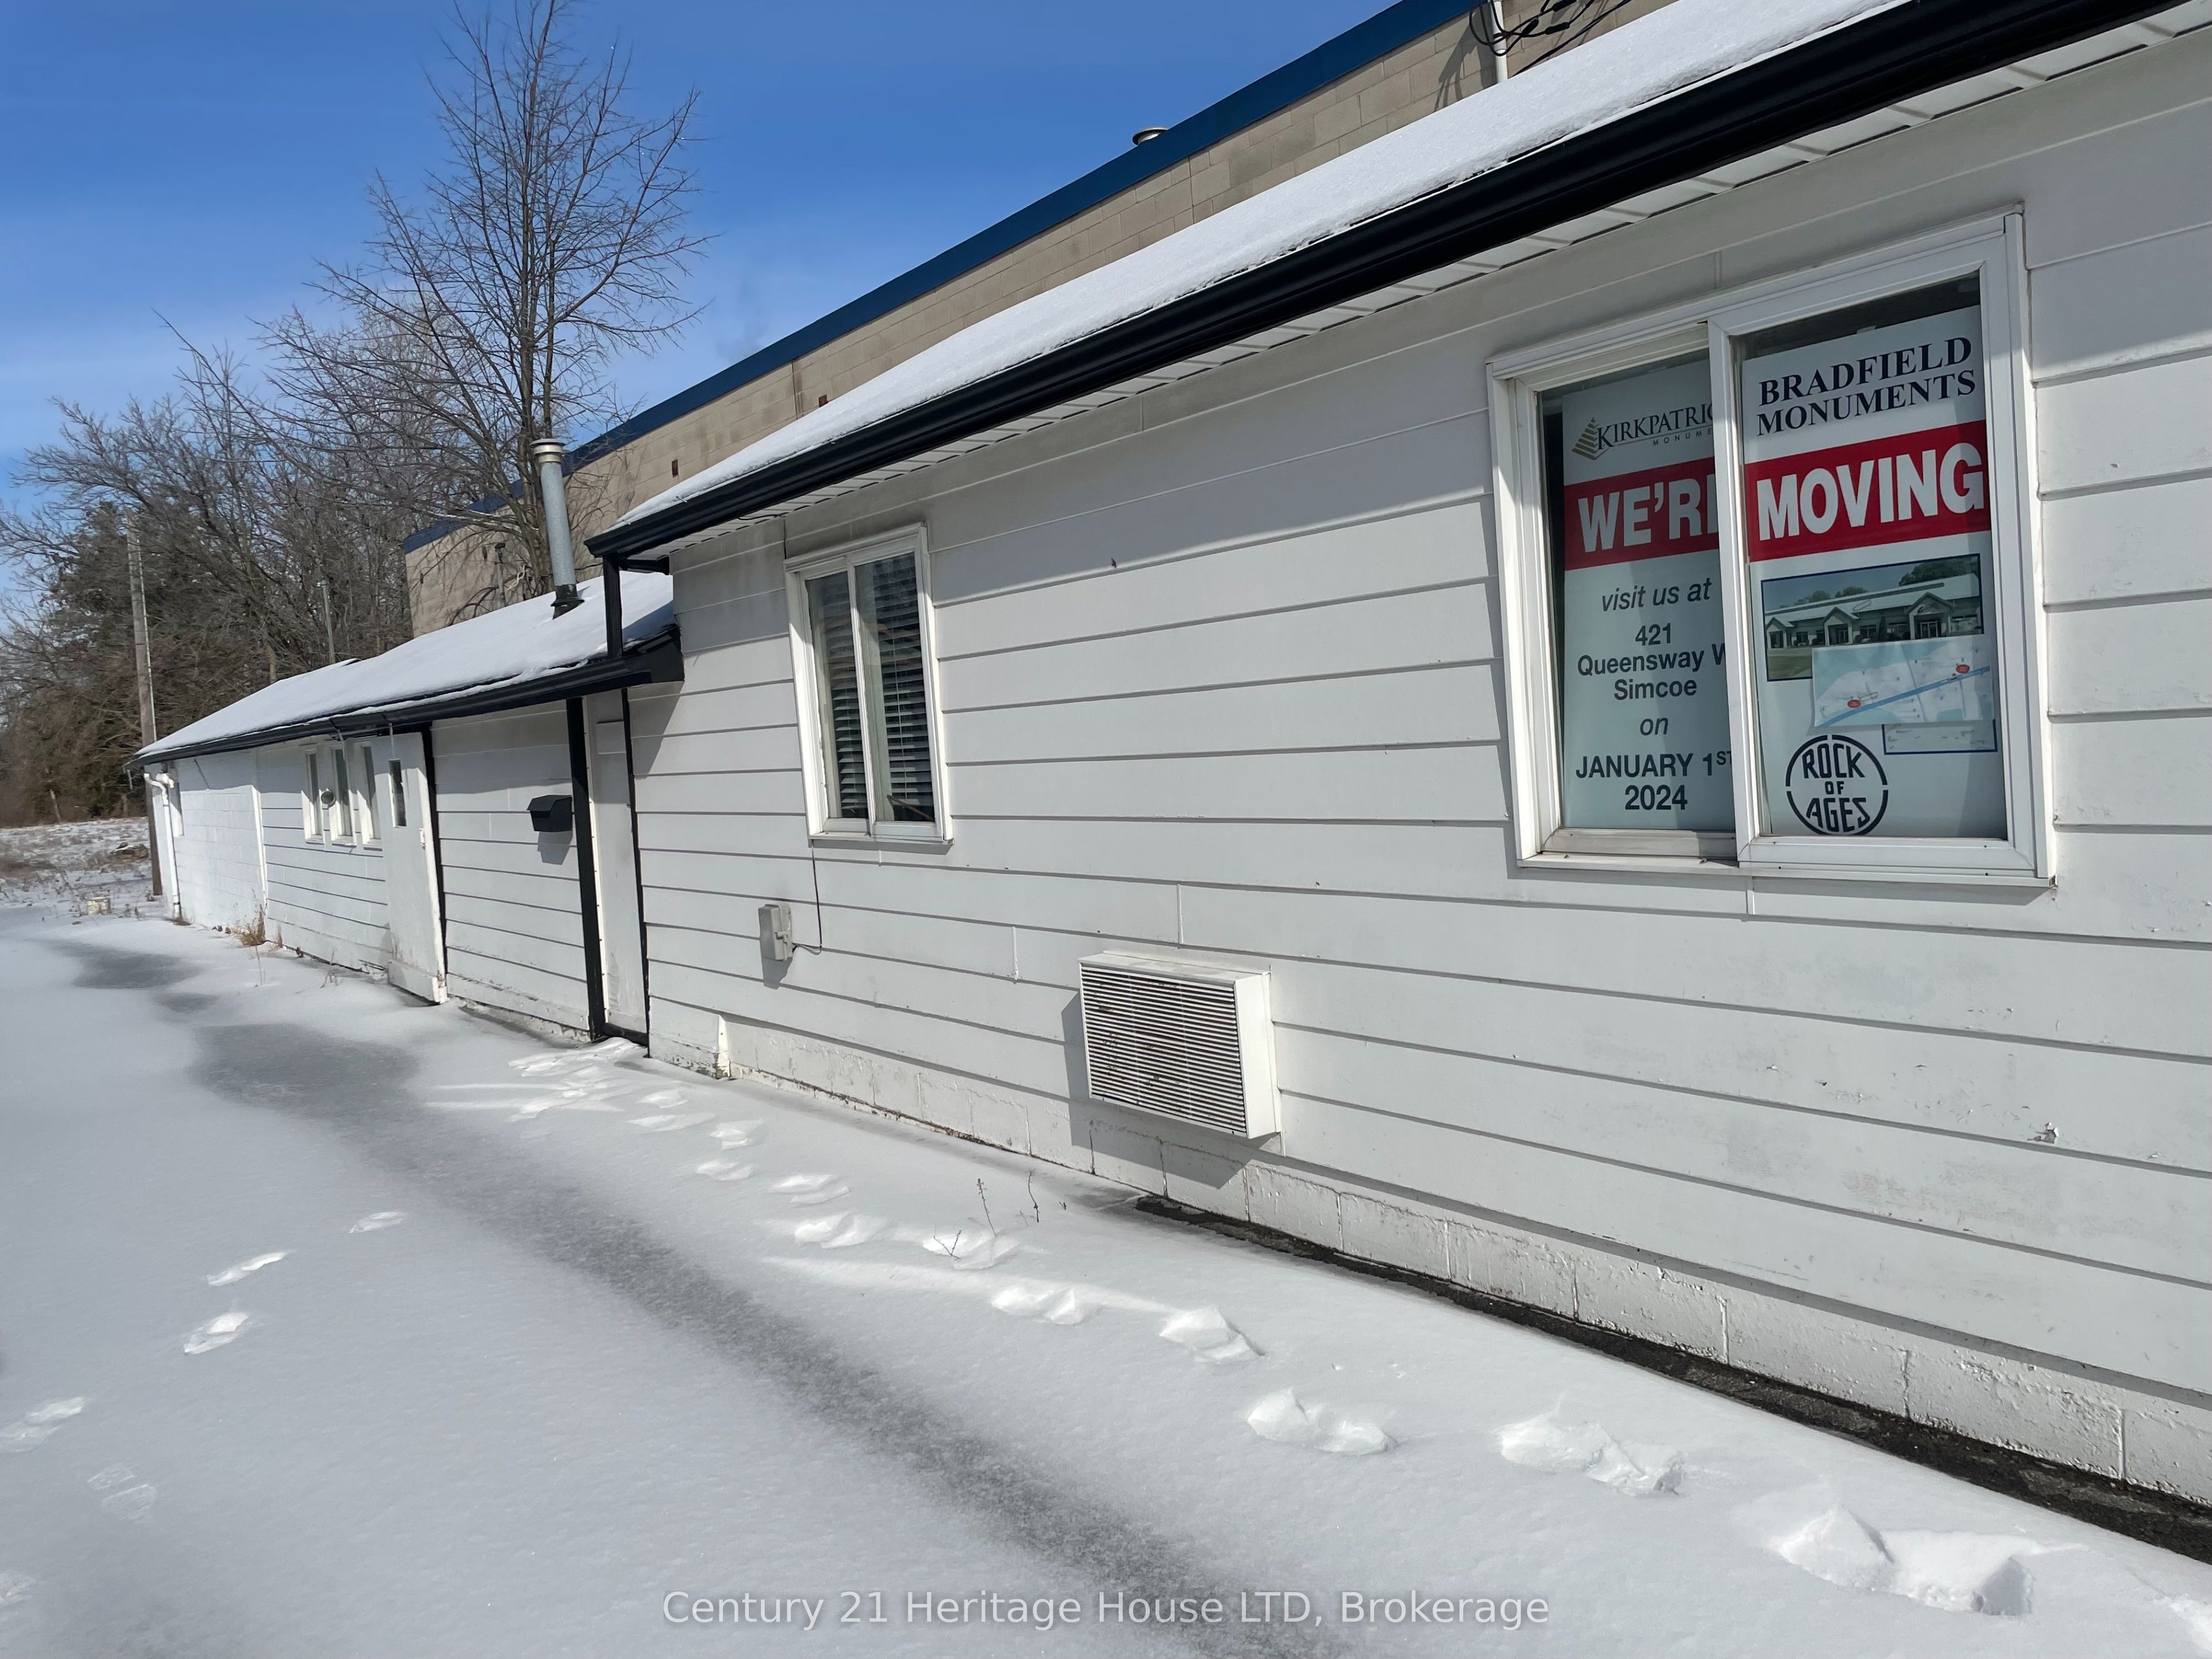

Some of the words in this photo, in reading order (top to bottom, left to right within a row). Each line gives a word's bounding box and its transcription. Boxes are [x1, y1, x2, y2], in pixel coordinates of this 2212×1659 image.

[1759, 337, 1972, 407] BRADFIELD
[1757, 369, 1976, 436] MONUMENTS
[1757, 442, 1984, 541] MOVING
[1602, 585, 1645, 612] visit
[1653, 586, 1680, 605] us
[1687, 578, 1712, 601] at
[1635, 623, 1671, 646] 421
[1577, 650, 1705, 676] Queensway
[1614, 679, 1697, 700] Simcoe
[1639, 717, 1668, 736] on
[1576, 753, 1694, 778] JANUARY
[1802, 743, 1865, 779] ROCK
[1625, 785, 1688, 810] 2024
[1824, 781, 1844, 794] OF
[1806, 797, 1870, 832] AGES
